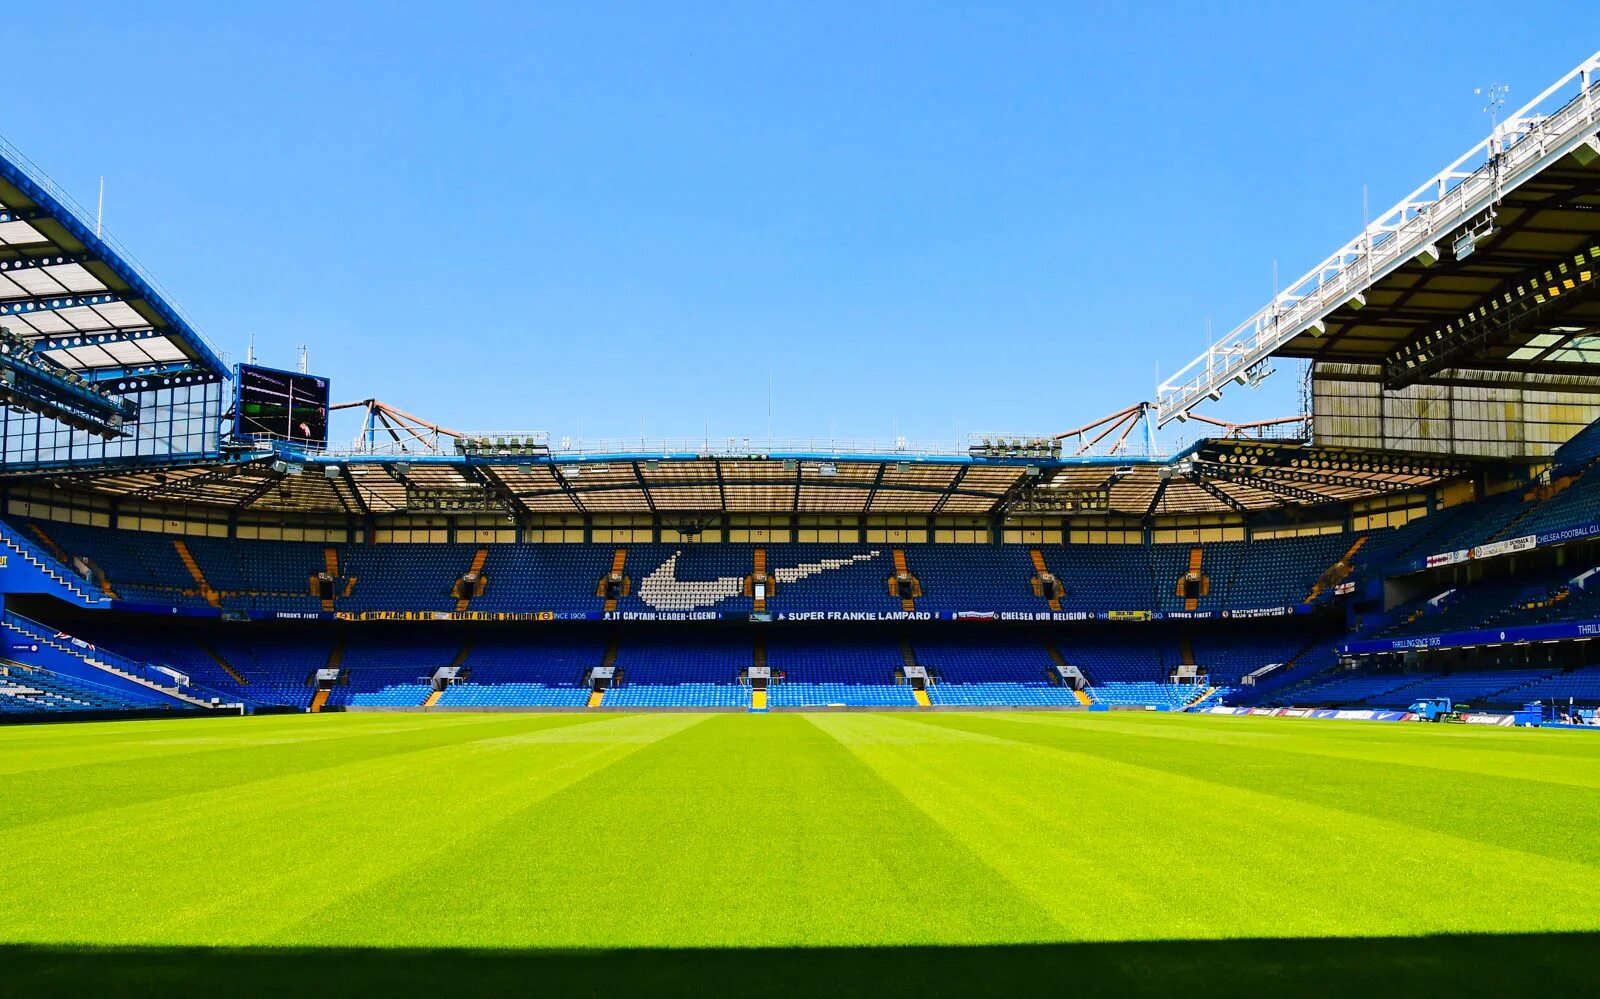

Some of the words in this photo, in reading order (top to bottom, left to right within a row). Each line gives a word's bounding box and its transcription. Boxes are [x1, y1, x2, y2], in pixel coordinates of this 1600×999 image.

[1536, 532, 1561, 544] CHELSEA
[1560, 527, 1589, 540] FOOTBALL
[349, 612, 363, 620] THE
[411, 612, 421, 620] TO
[423, 612, 433, 620] BE
[450, 611, 474, 620] EVERY
[477, 611, 501, 620] OTHER
[503, 612, 540, 621] SATURDAY
[788, 612, 825, 620] SUPER
[827, 612, 876, 620] FRANKIE
[878, 612, 931, 620] LAMPARD
[1001, 612, 1034, 620] CHELSEA
[1035, 612, 1050, 620] OUR
[1053, 612, 1087, 620] RELIGION
[1392, 639, 1416, 648] THRILLING
